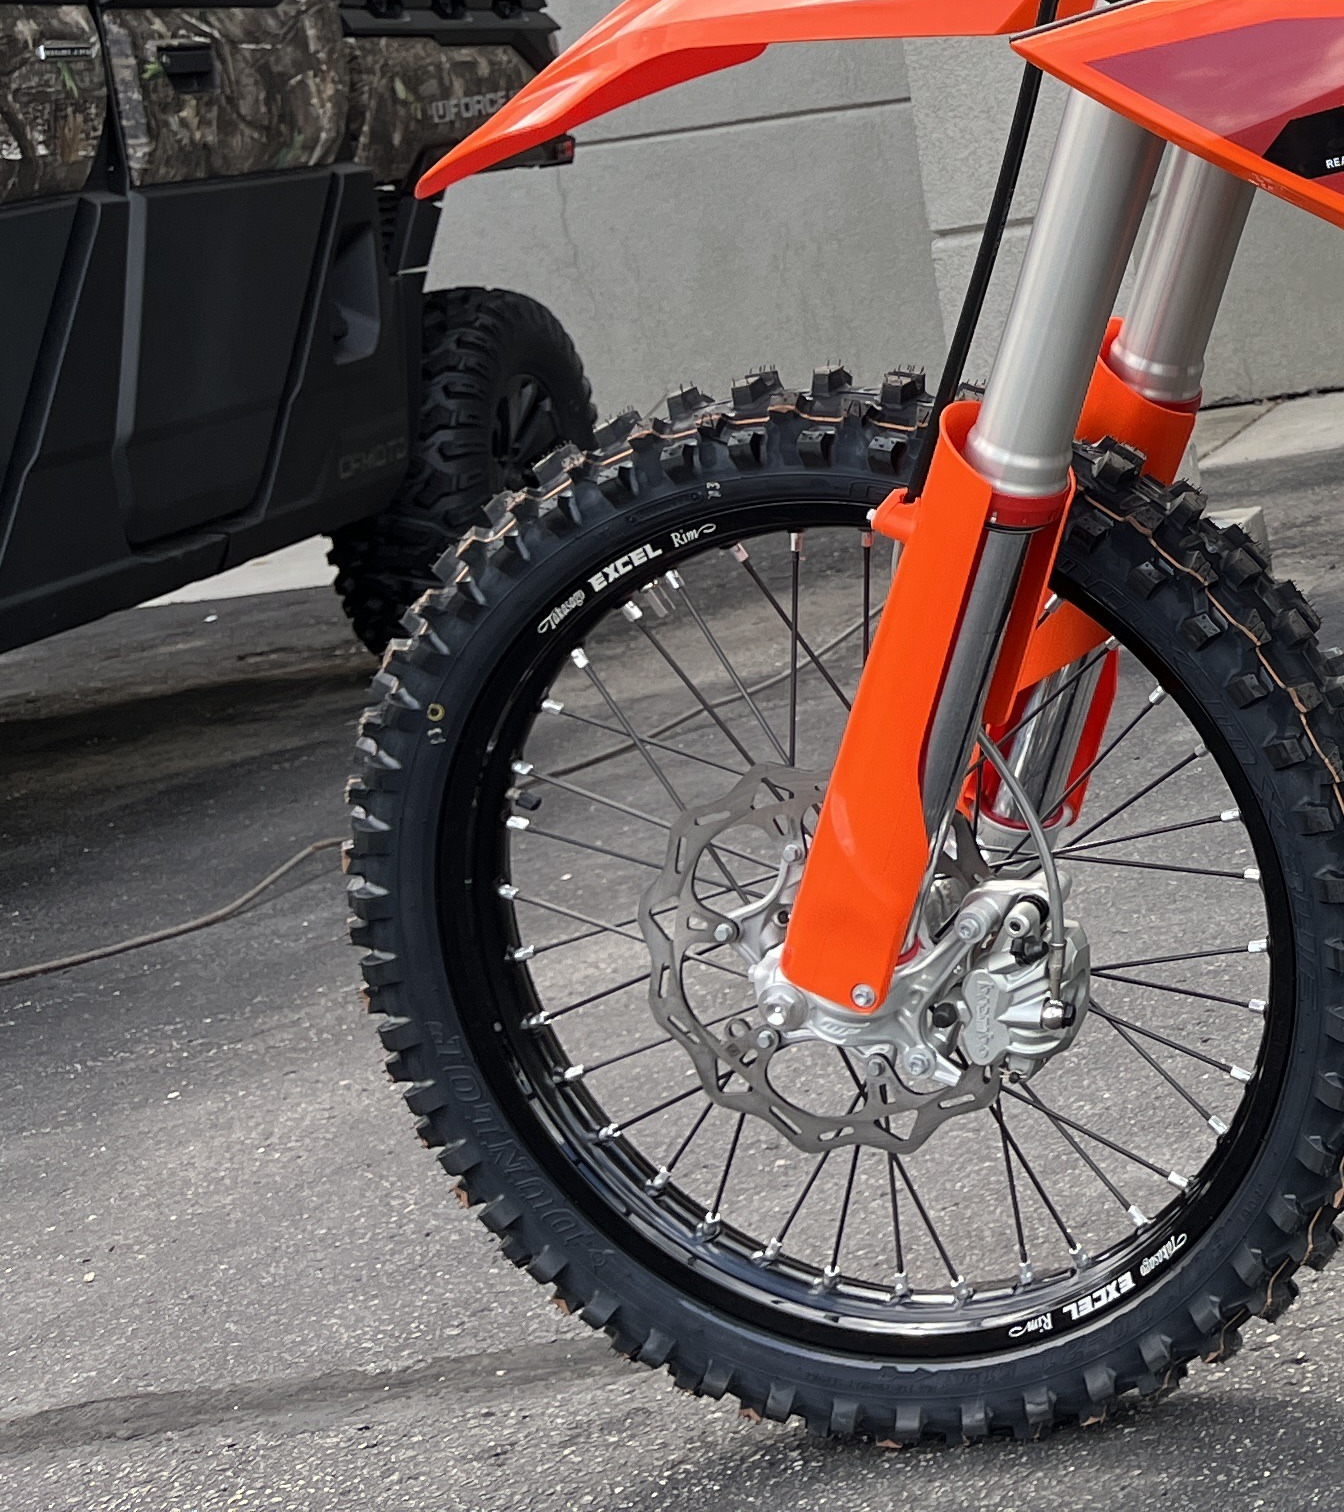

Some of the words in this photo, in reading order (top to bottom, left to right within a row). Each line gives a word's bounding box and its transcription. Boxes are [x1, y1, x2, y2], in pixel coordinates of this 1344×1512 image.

[587, 543, 663, 593] EXCEL
[670, 524, 710, 548] Rim
[1062, 1271, 1137, 1321] EXCEL
[1014, 1313, 1054, 1338] Rim
